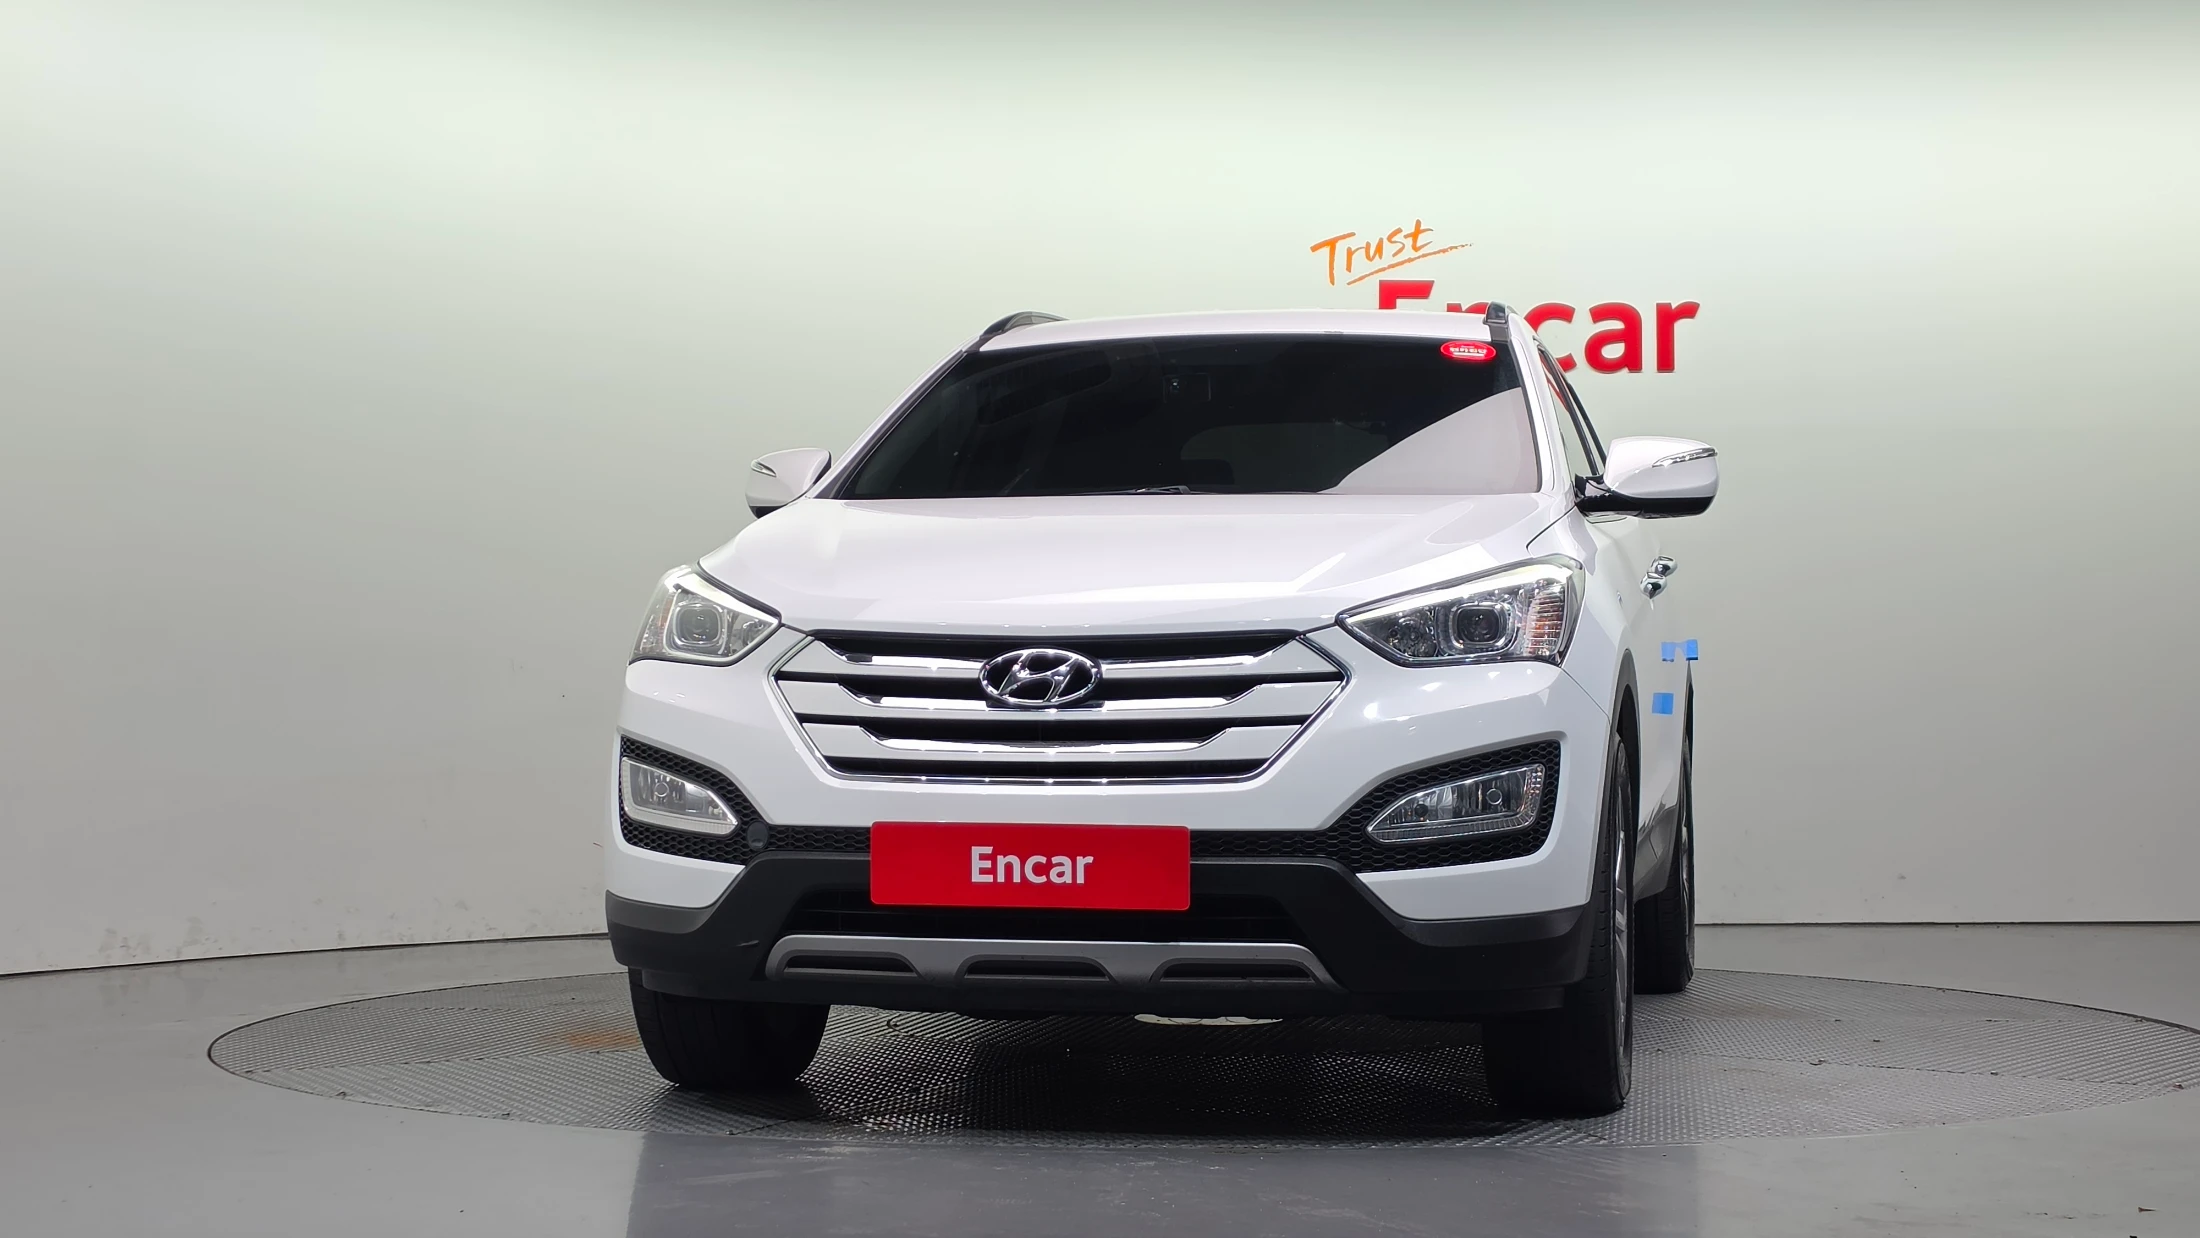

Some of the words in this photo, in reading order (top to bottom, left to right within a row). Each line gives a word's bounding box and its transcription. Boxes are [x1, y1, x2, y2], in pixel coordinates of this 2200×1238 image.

[1310, 218, 1434, 286] Trust
[1378, 279, 1701, 374] car
[970, 845, 1094, 885] Encar
